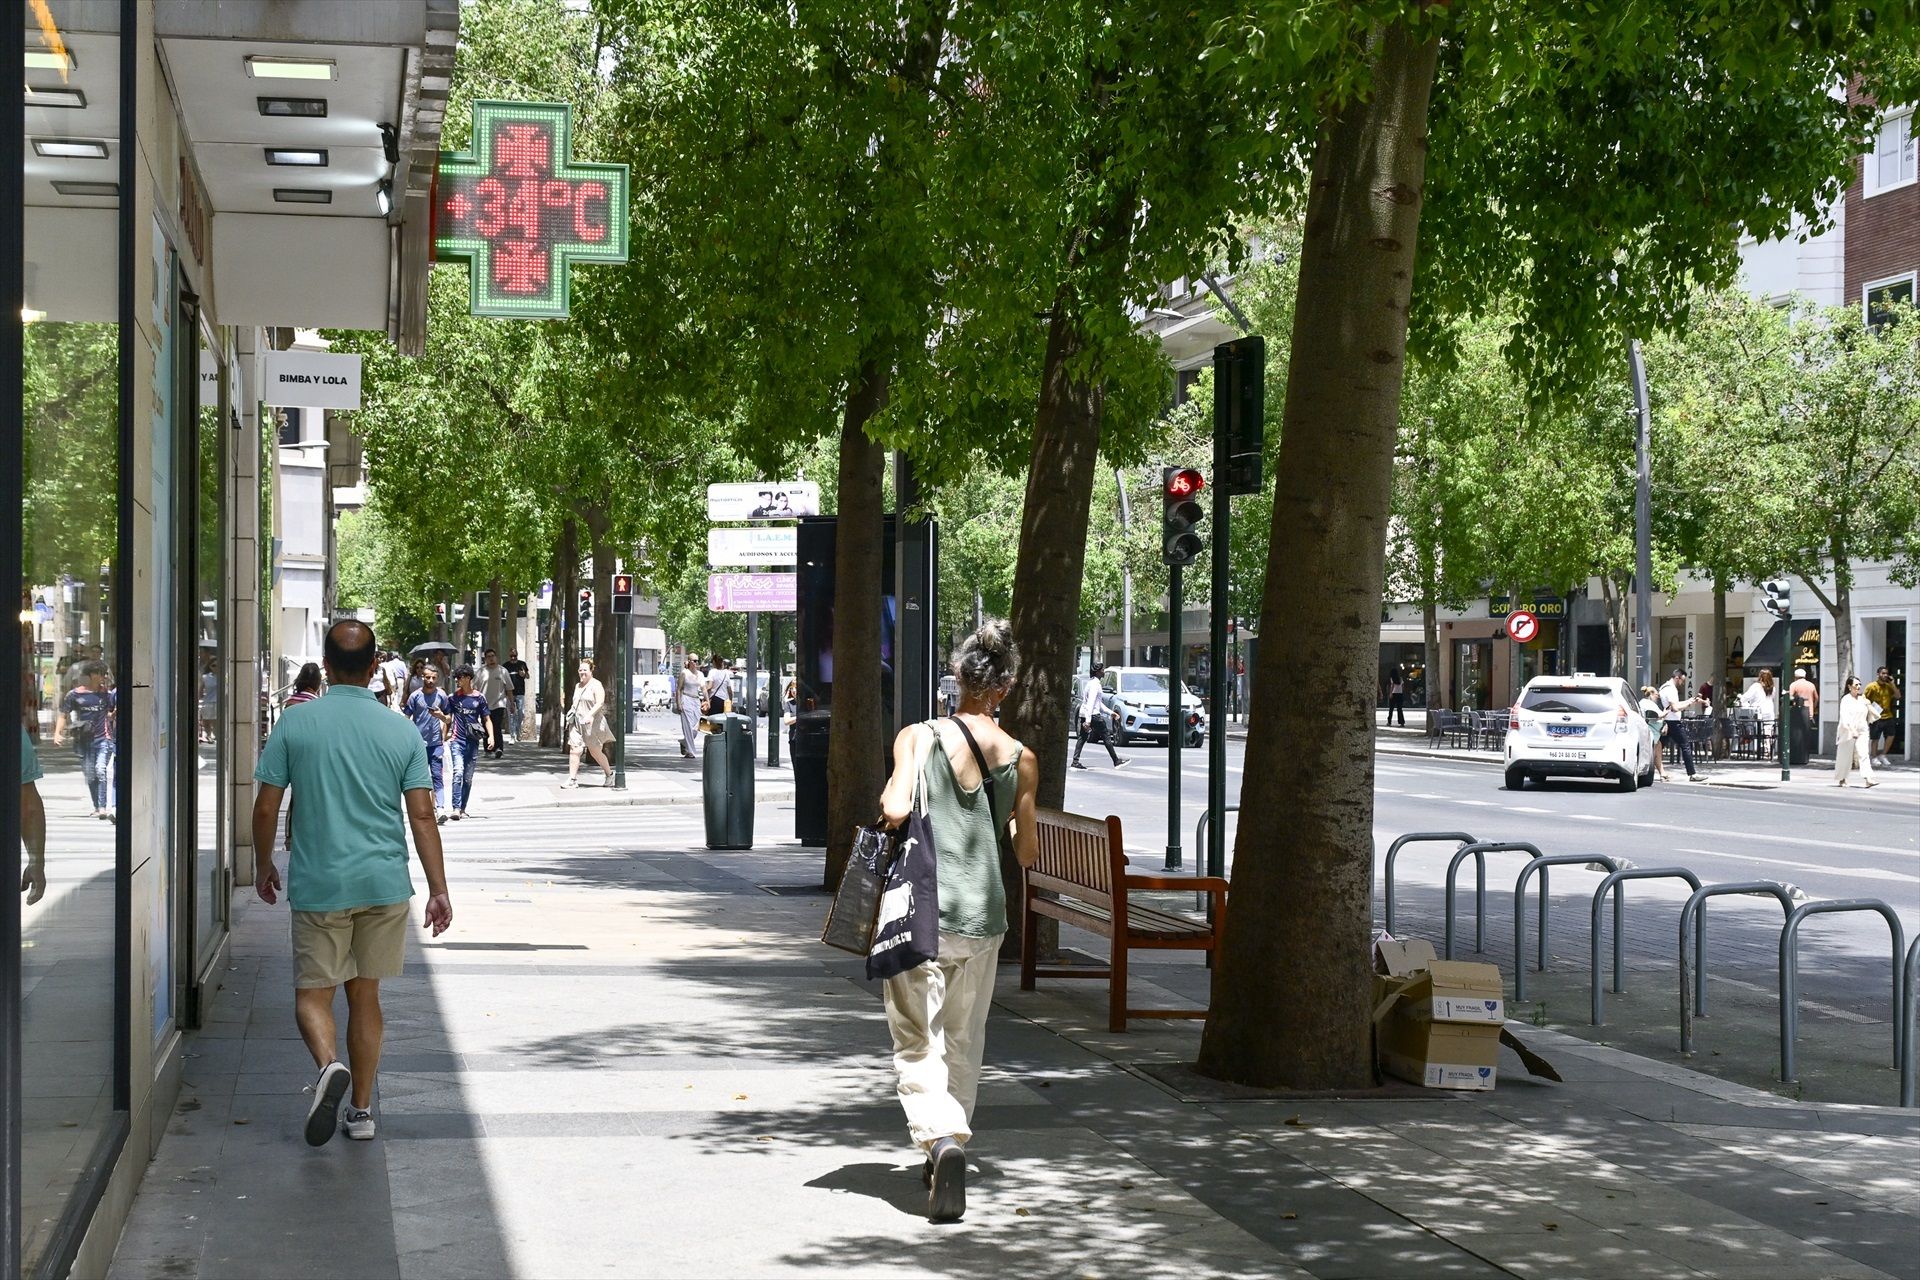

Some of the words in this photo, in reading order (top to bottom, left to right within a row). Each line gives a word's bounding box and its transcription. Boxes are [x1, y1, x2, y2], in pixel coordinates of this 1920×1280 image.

[279, 374, 312, 384] BIMBA
[313, 375, 321, 384] Y
[322, 376, 348, 385] LOLA
[1491, 603, 1537, 614] CORO
[1539, 603, 1562, 614] ORO
